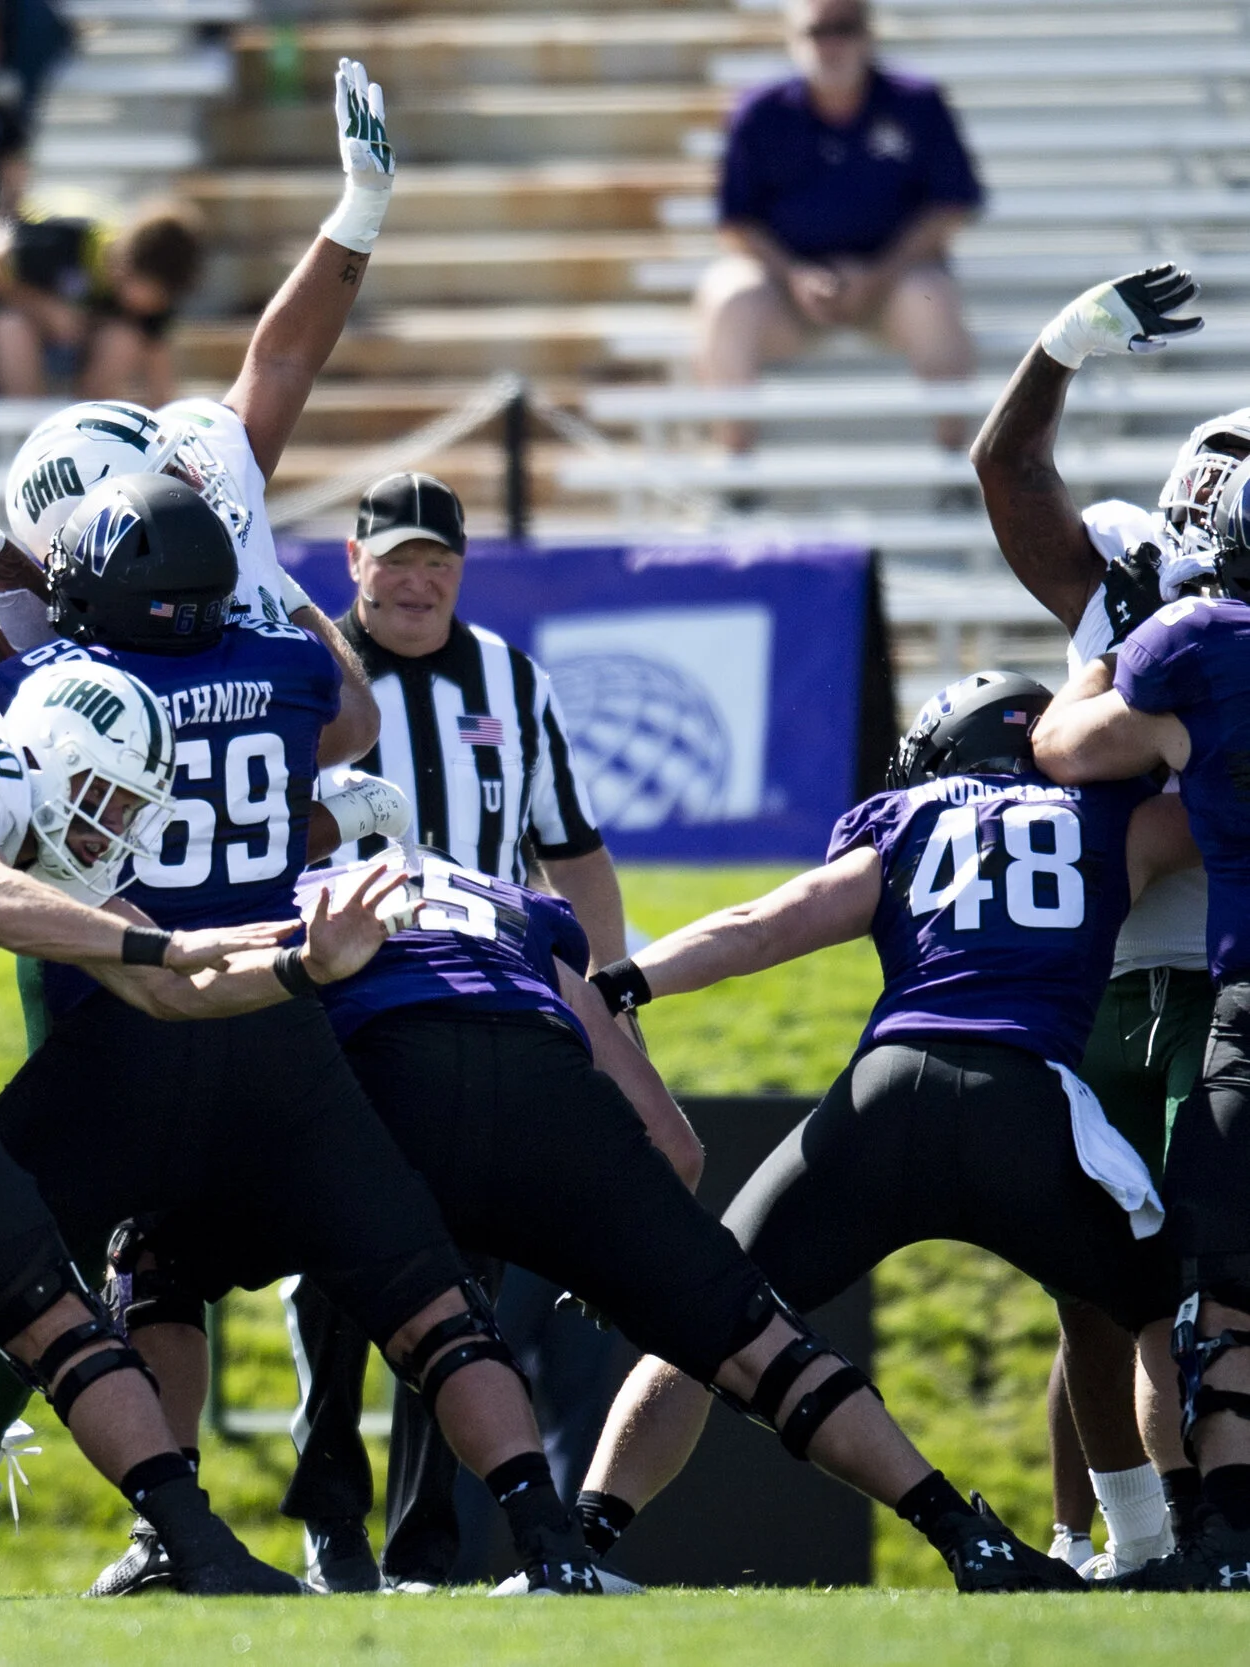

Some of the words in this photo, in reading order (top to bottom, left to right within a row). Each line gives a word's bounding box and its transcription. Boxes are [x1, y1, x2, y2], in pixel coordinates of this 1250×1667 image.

[21, 456, 85, 525] OHIO
[43, 677, 126, 736] OHIO
[132, 732, 290, 889] 69
[481, 780, 502, 813] U
[909, 804, 1086, 931] 48
